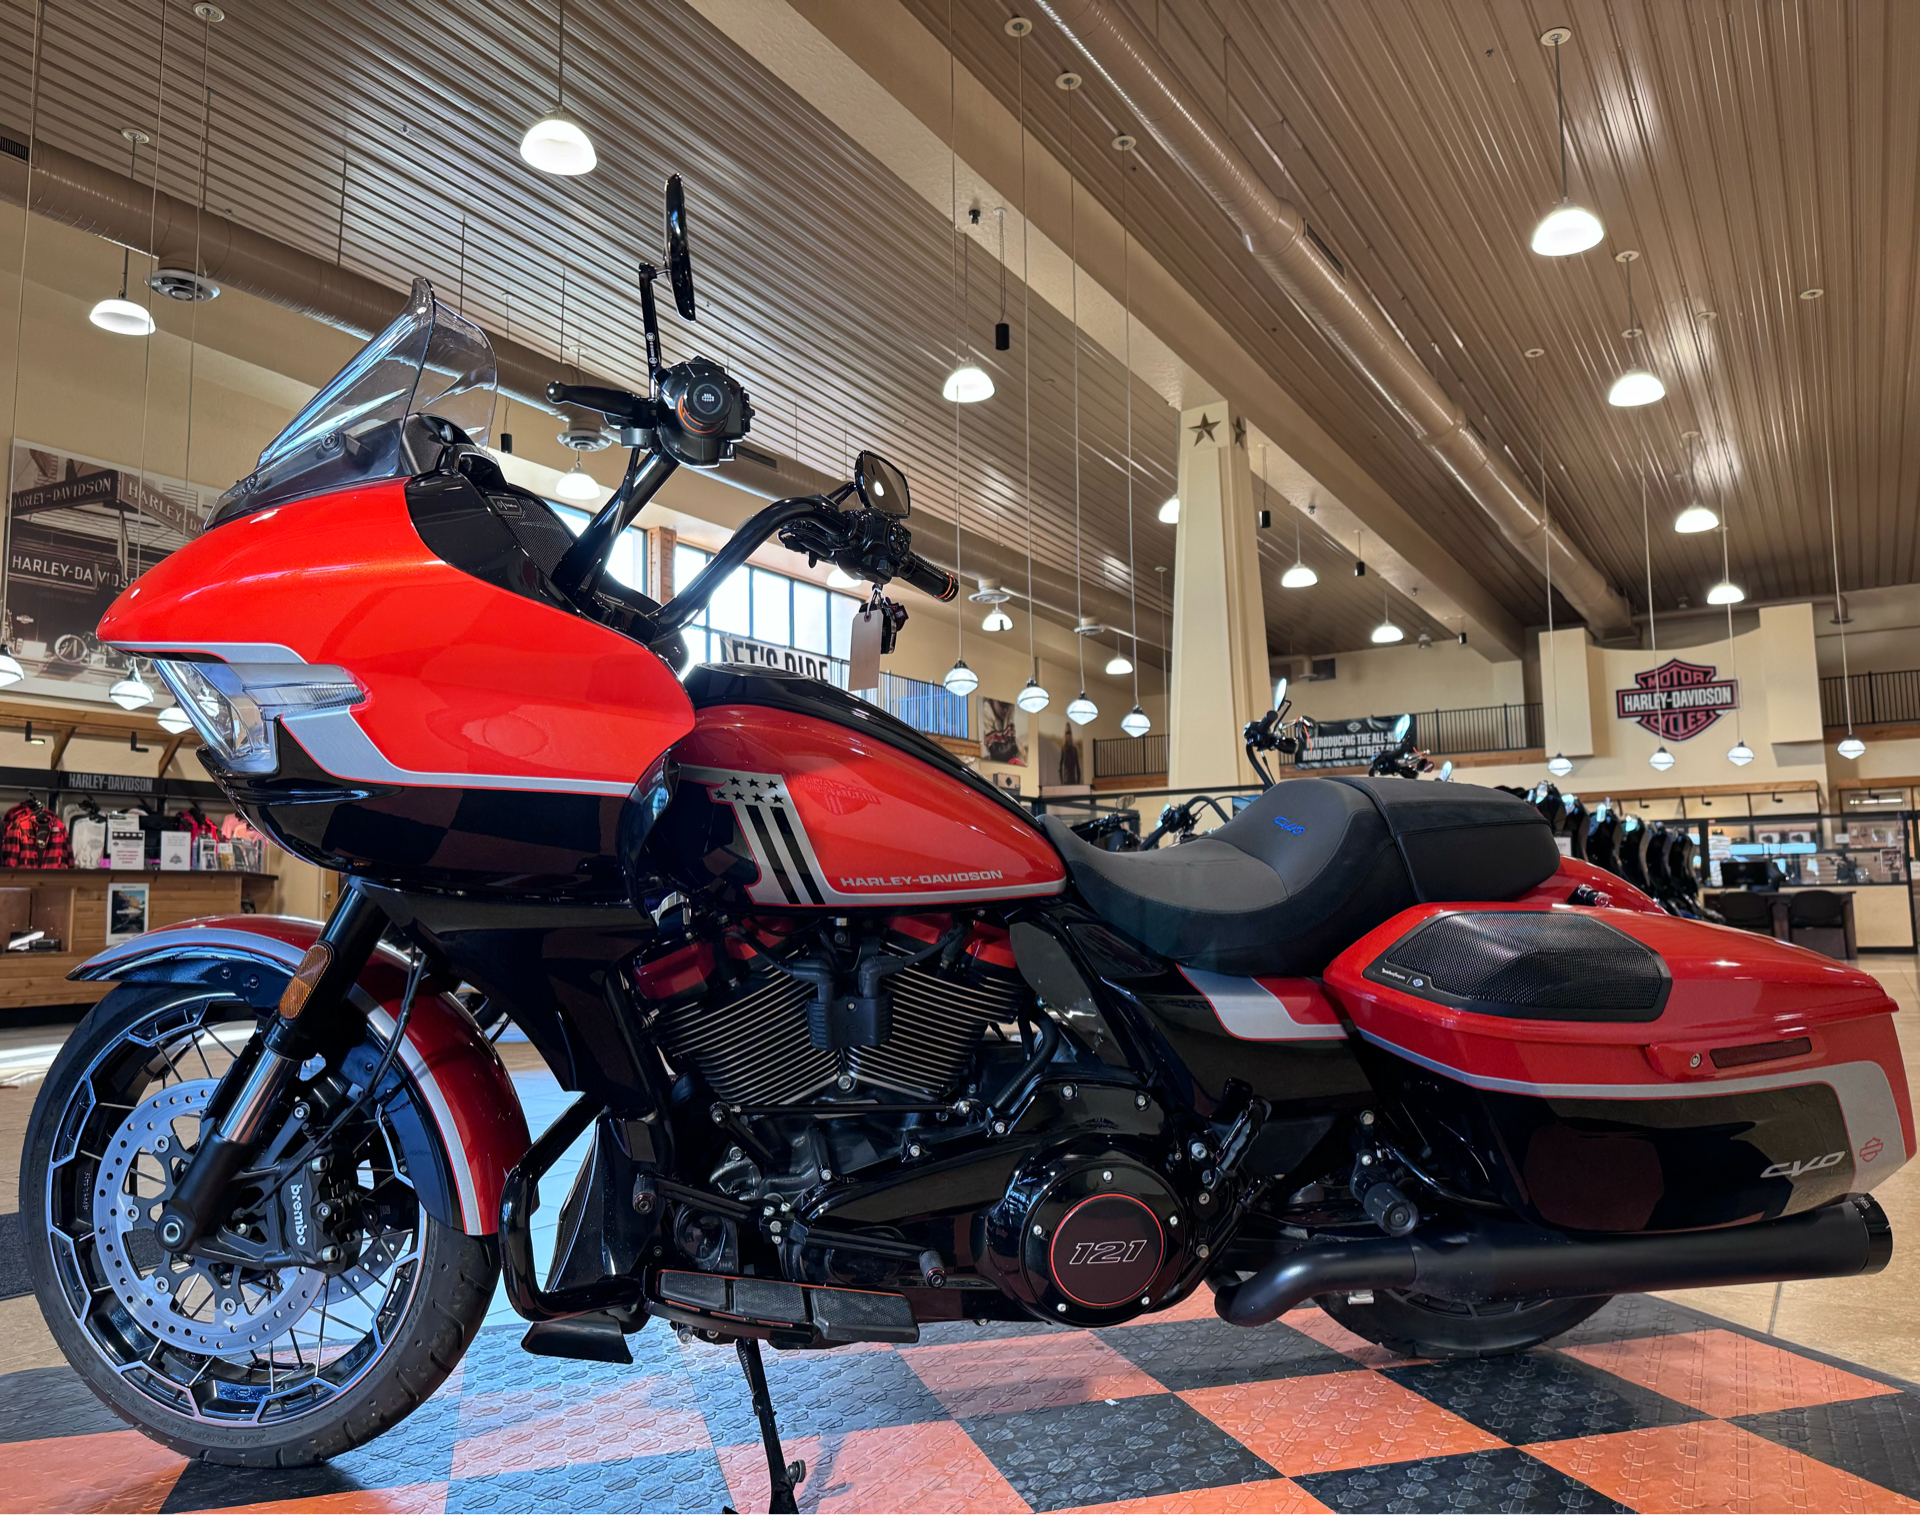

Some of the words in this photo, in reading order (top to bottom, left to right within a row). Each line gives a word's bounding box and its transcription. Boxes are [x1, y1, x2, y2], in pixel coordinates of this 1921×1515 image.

[128, 482, 204, 535] HARLEY-DA
[1647, 667, 1705, 688] MOTOR
[1624, 686, 1732, 712] HARLEY-DAVIDSON
[1649, 711, 1708, 735] CYCLES
[1306, 733, 1356, 749] INTRODUCING
[1356, 732, 1371, 745] THE
[1302, 748, 1322, 761] ROAD
[1323, 747, 1344, 760] GLIDE
[68, 773, 153, 793] HARLEY-DAVIDSON
[1273, 815, 1306, 835] CVO
[840, 869, 1004, 887] HARLEY-DAVIDSON
[1760, 1150, 1846, 1178] CVO
[290, 1184, 308, 1246] brembo
[1068, 1239, 1148, 1265] 121
